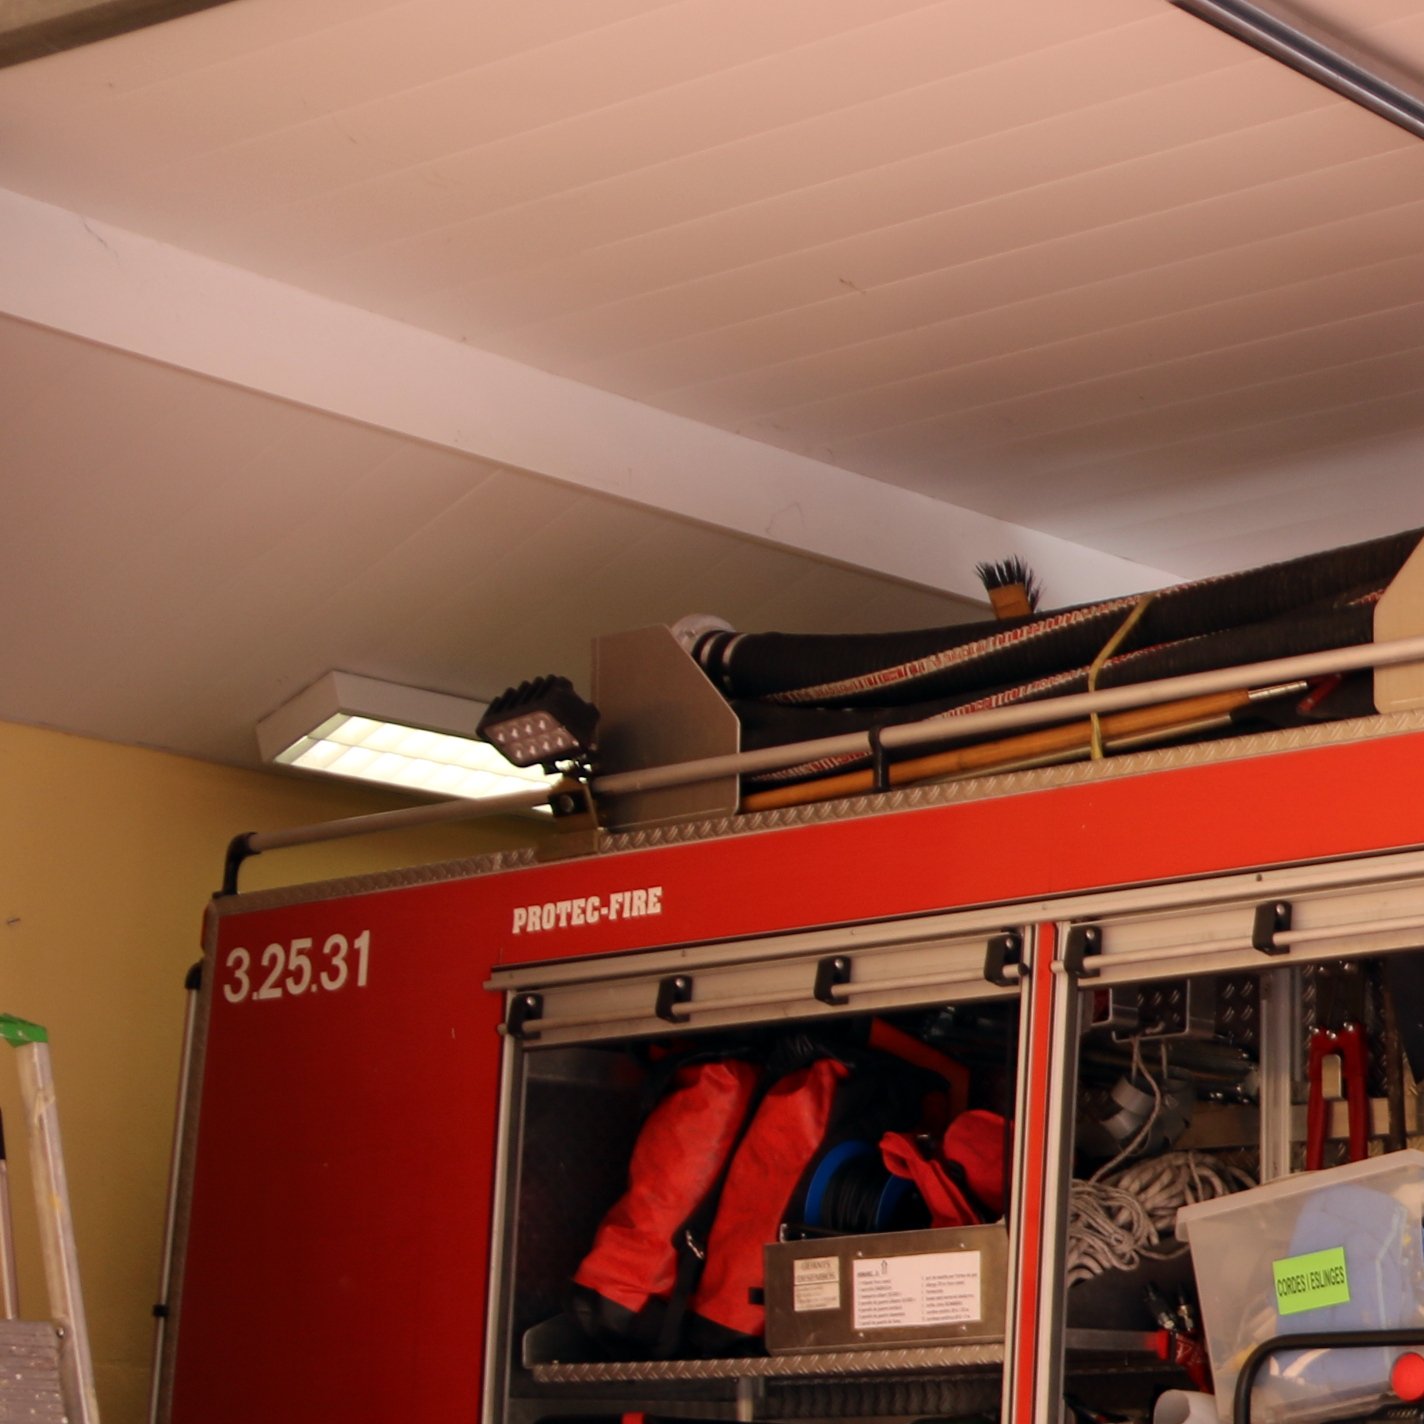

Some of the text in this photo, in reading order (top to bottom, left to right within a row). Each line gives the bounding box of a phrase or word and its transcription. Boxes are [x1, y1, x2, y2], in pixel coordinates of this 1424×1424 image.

[512, 886, 663, 935] PROTEC-FIRE
[222, 929, 371, 1005] 3.25.31
[1277, 1274, 1306, 1297] CORDES
[1310, 1266, 1345, 1290] ESLINGES
